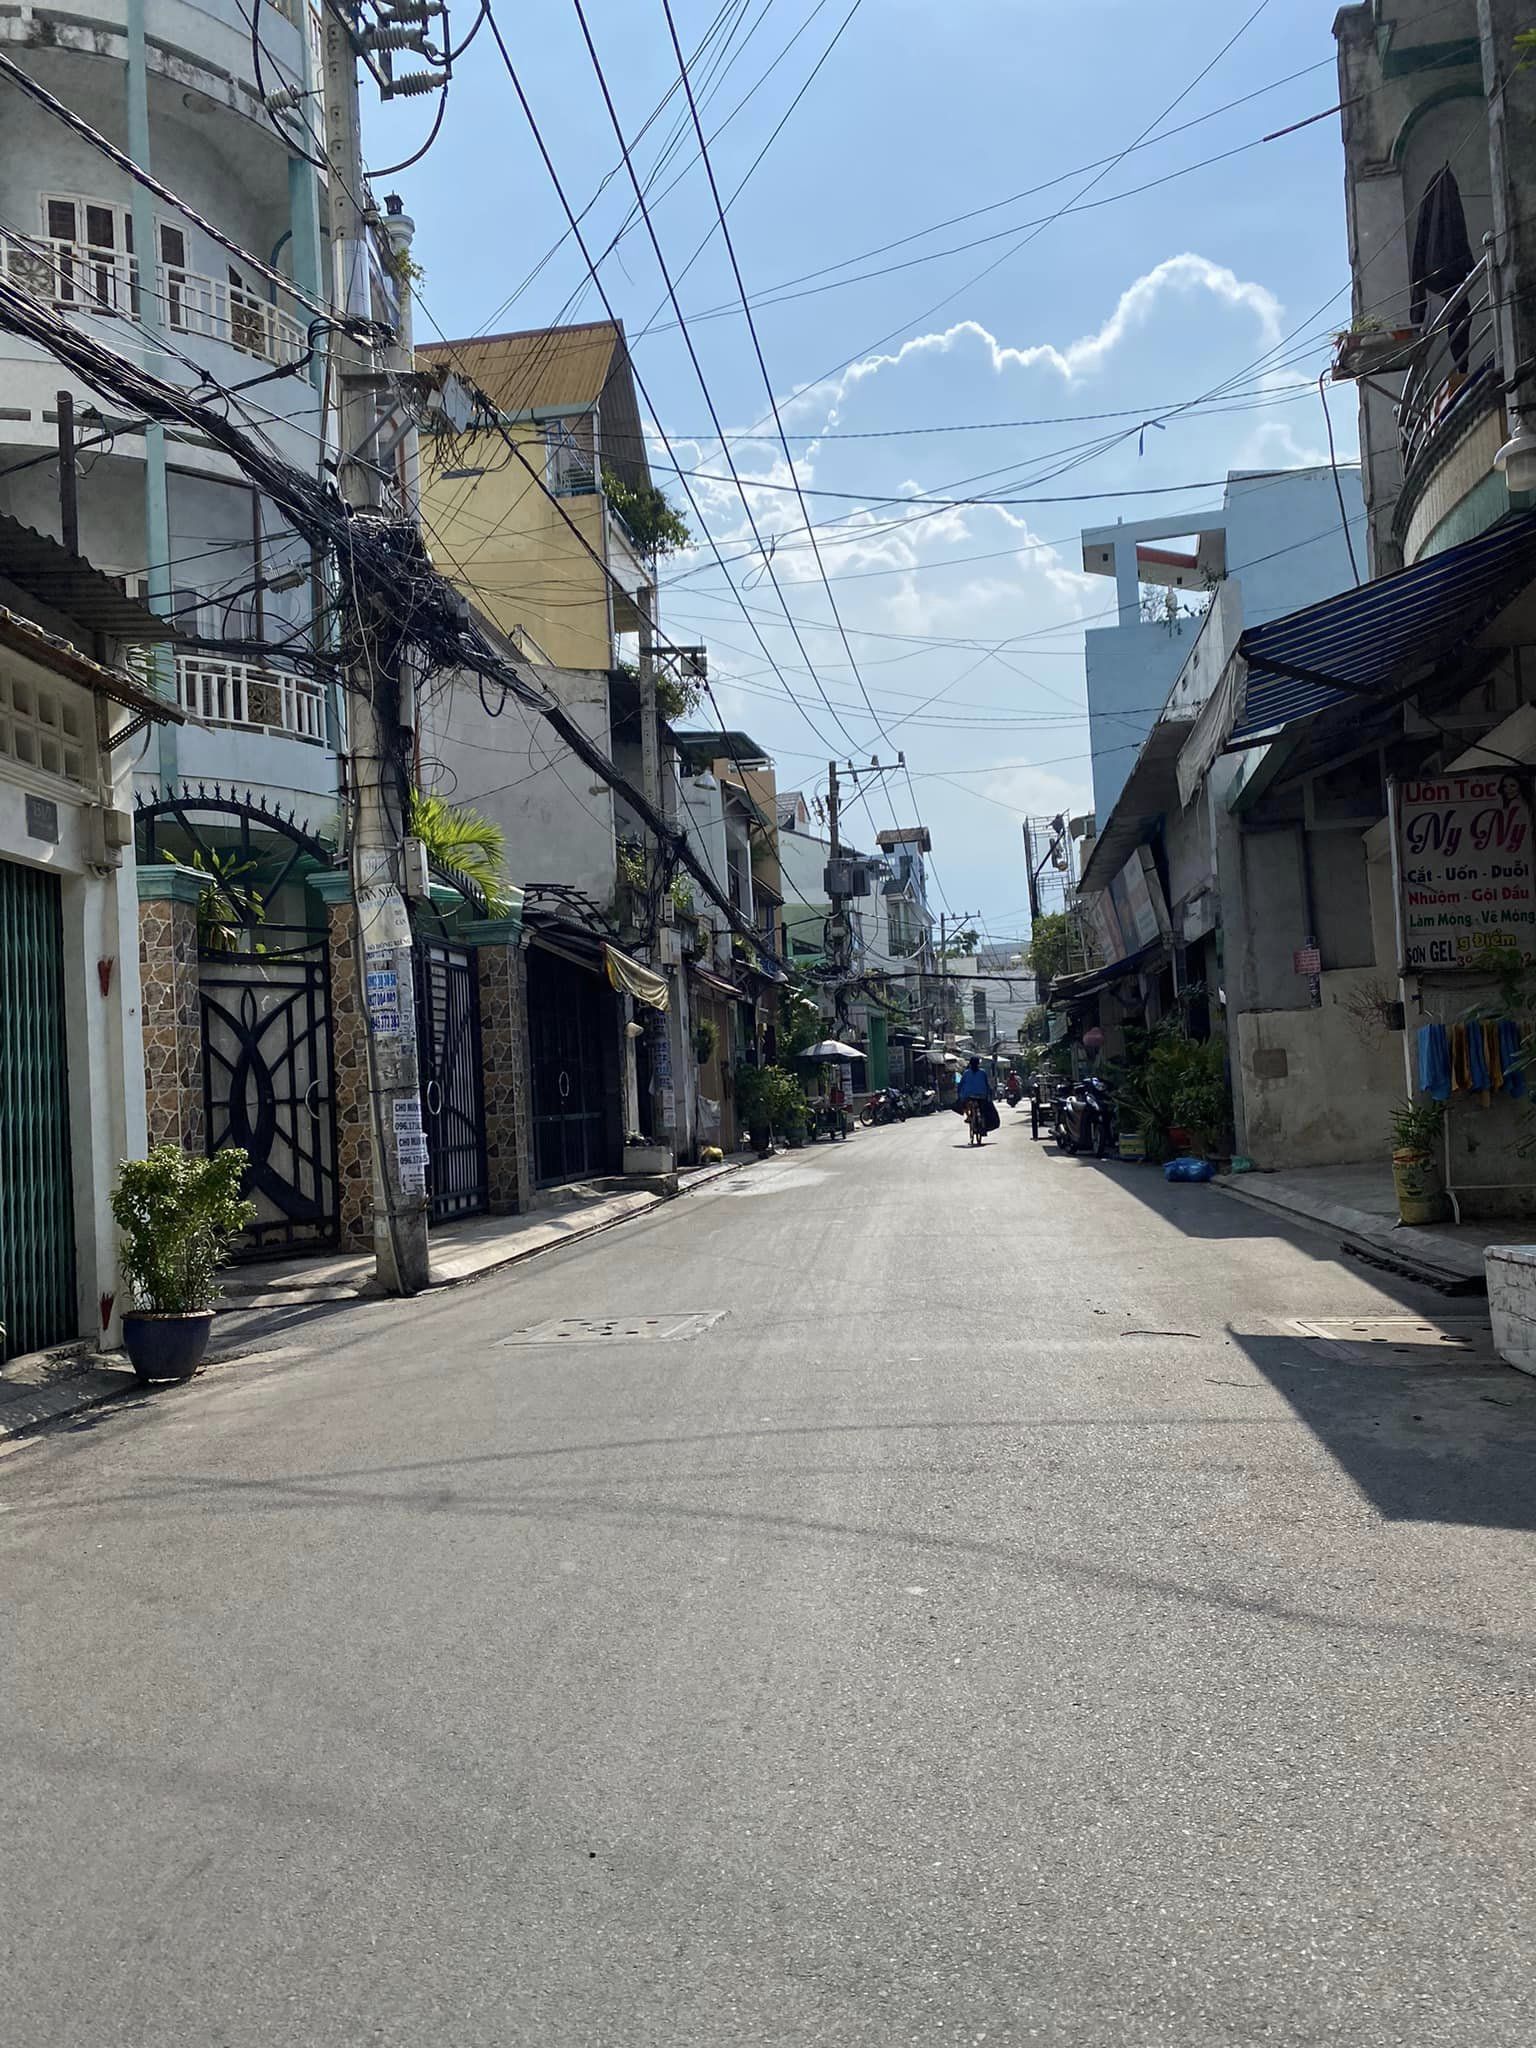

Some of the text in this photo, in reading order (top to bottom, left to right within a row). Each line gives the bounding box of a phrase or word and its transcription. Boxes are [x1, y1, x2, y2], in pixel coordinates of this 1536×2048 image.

[1454, 777, 1497, 799] Tóc
[1407, 807, 1527, 856] Ny Ny
[1408, 860, 1528, 883] Cắt Uốn Duỗi
[1408, 890, 1460, 905] Nhuộm
[1472, 888, 1497, 904] Gội
[1410, 914, 1434, 928] Làm
[1438, 911, 1471, 927] Móng
[1501, 909, 1535, 924] Móng
[1430, 940, 1457, 962] GEL
